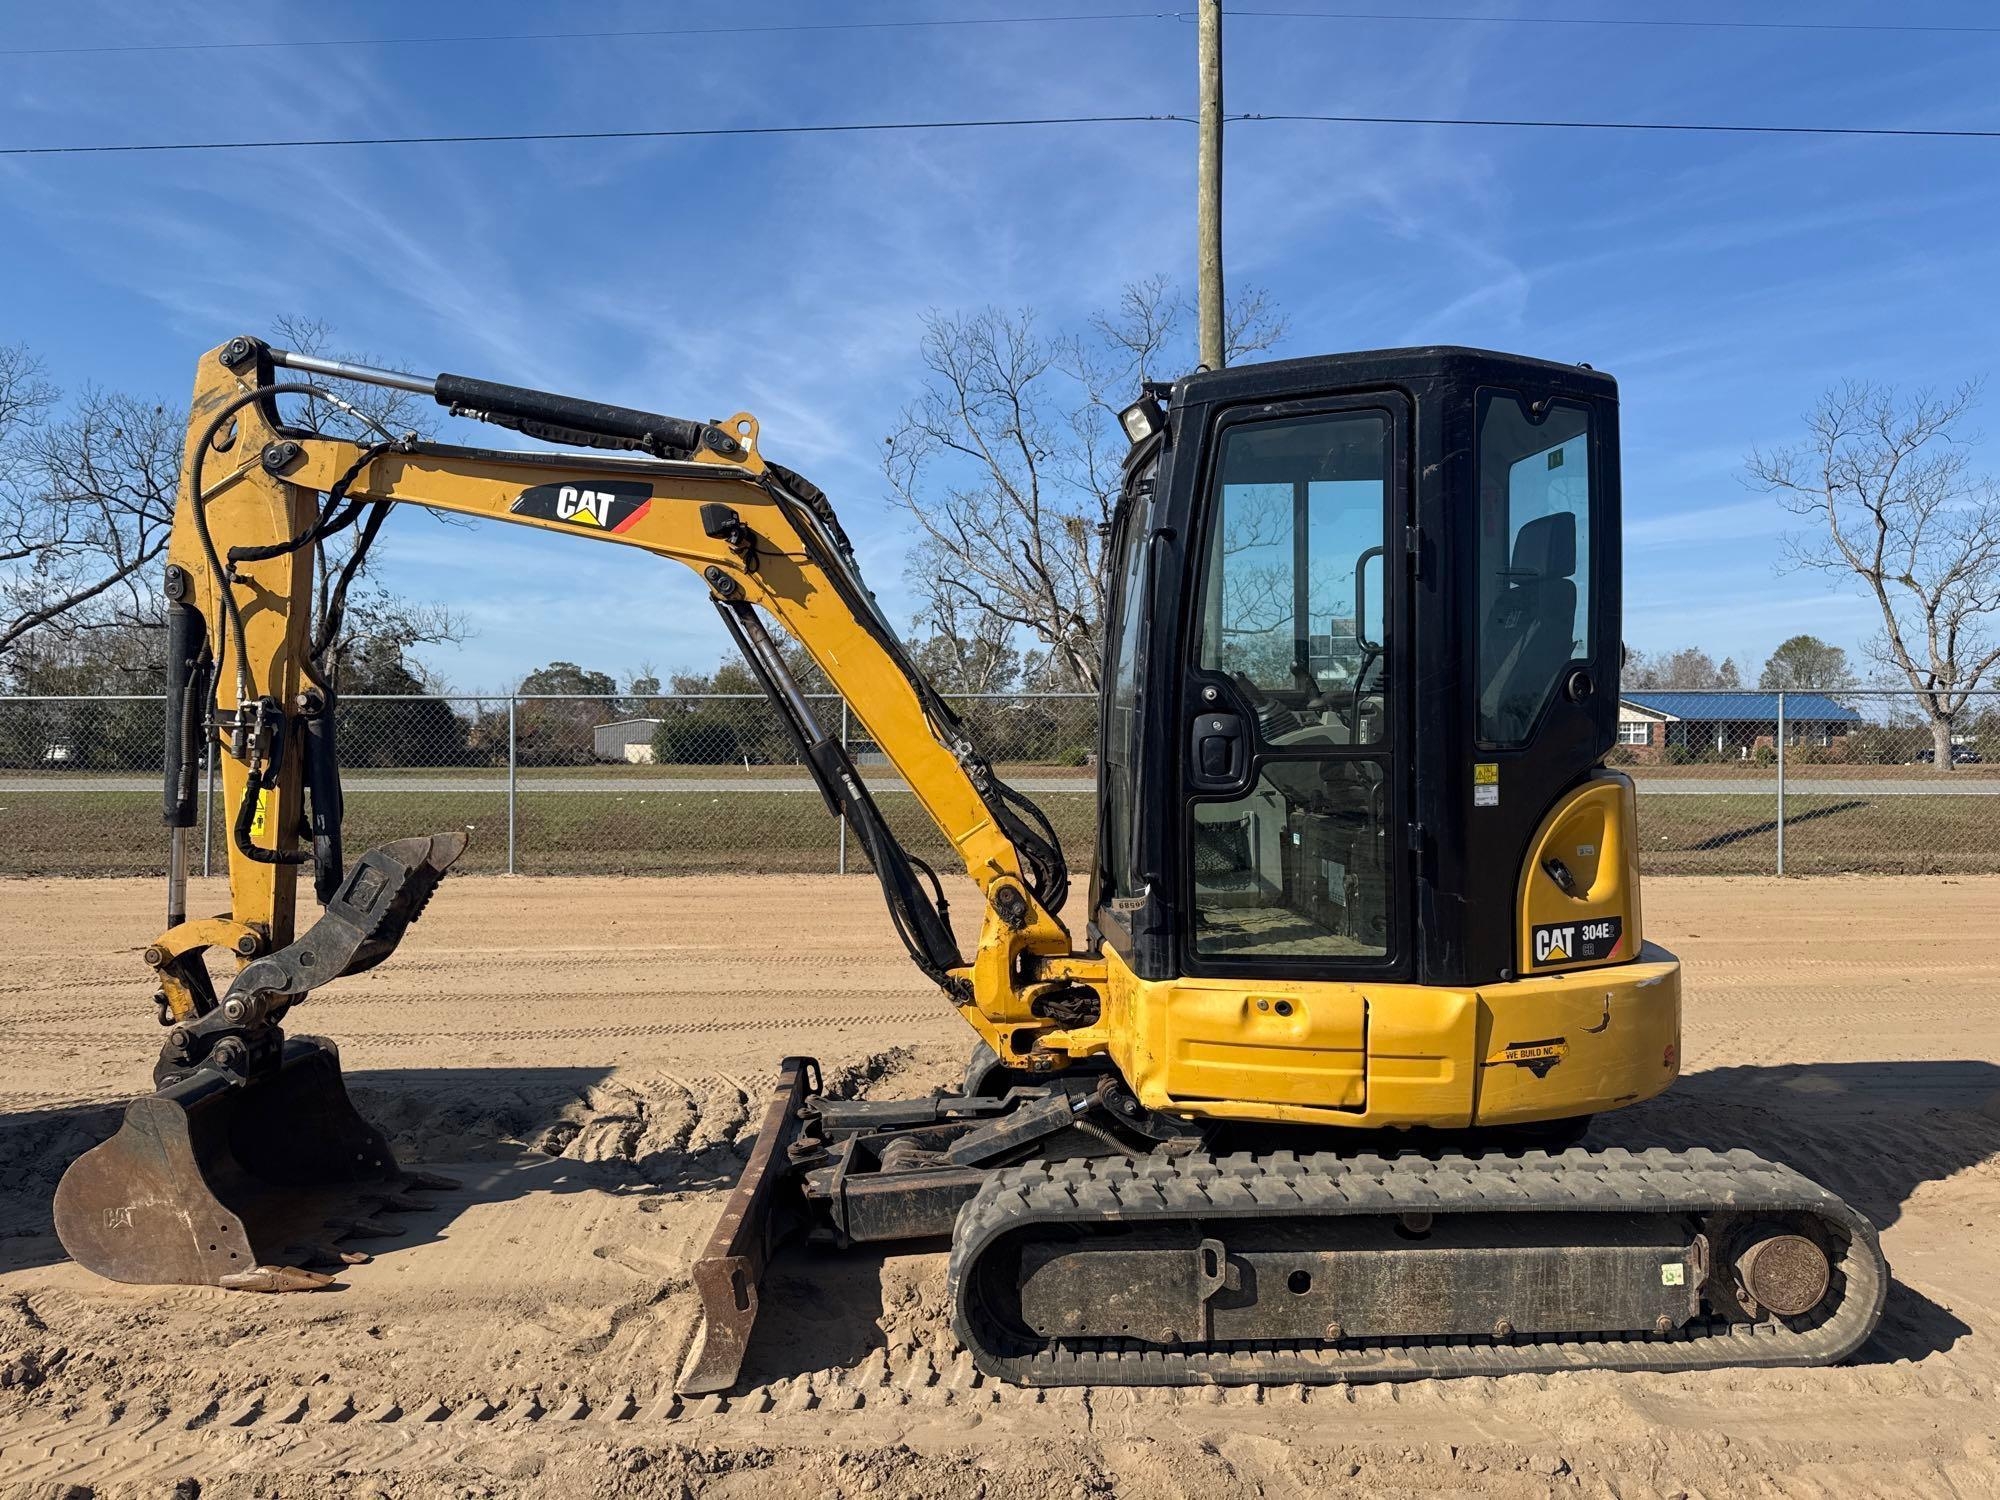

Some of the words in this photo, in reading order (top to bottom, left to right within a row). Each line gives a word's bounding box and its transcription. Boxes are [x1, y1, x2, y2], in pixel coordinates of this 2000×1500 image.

[556, 485, 615, 527] CAT
[1536, 927, 1575, 962] CAT
[1506, 1050, 1518, 1059] WE
[1520, 1048, 1541, 1058] BUILD
[1543, 1046, 1553, 1055] NC
